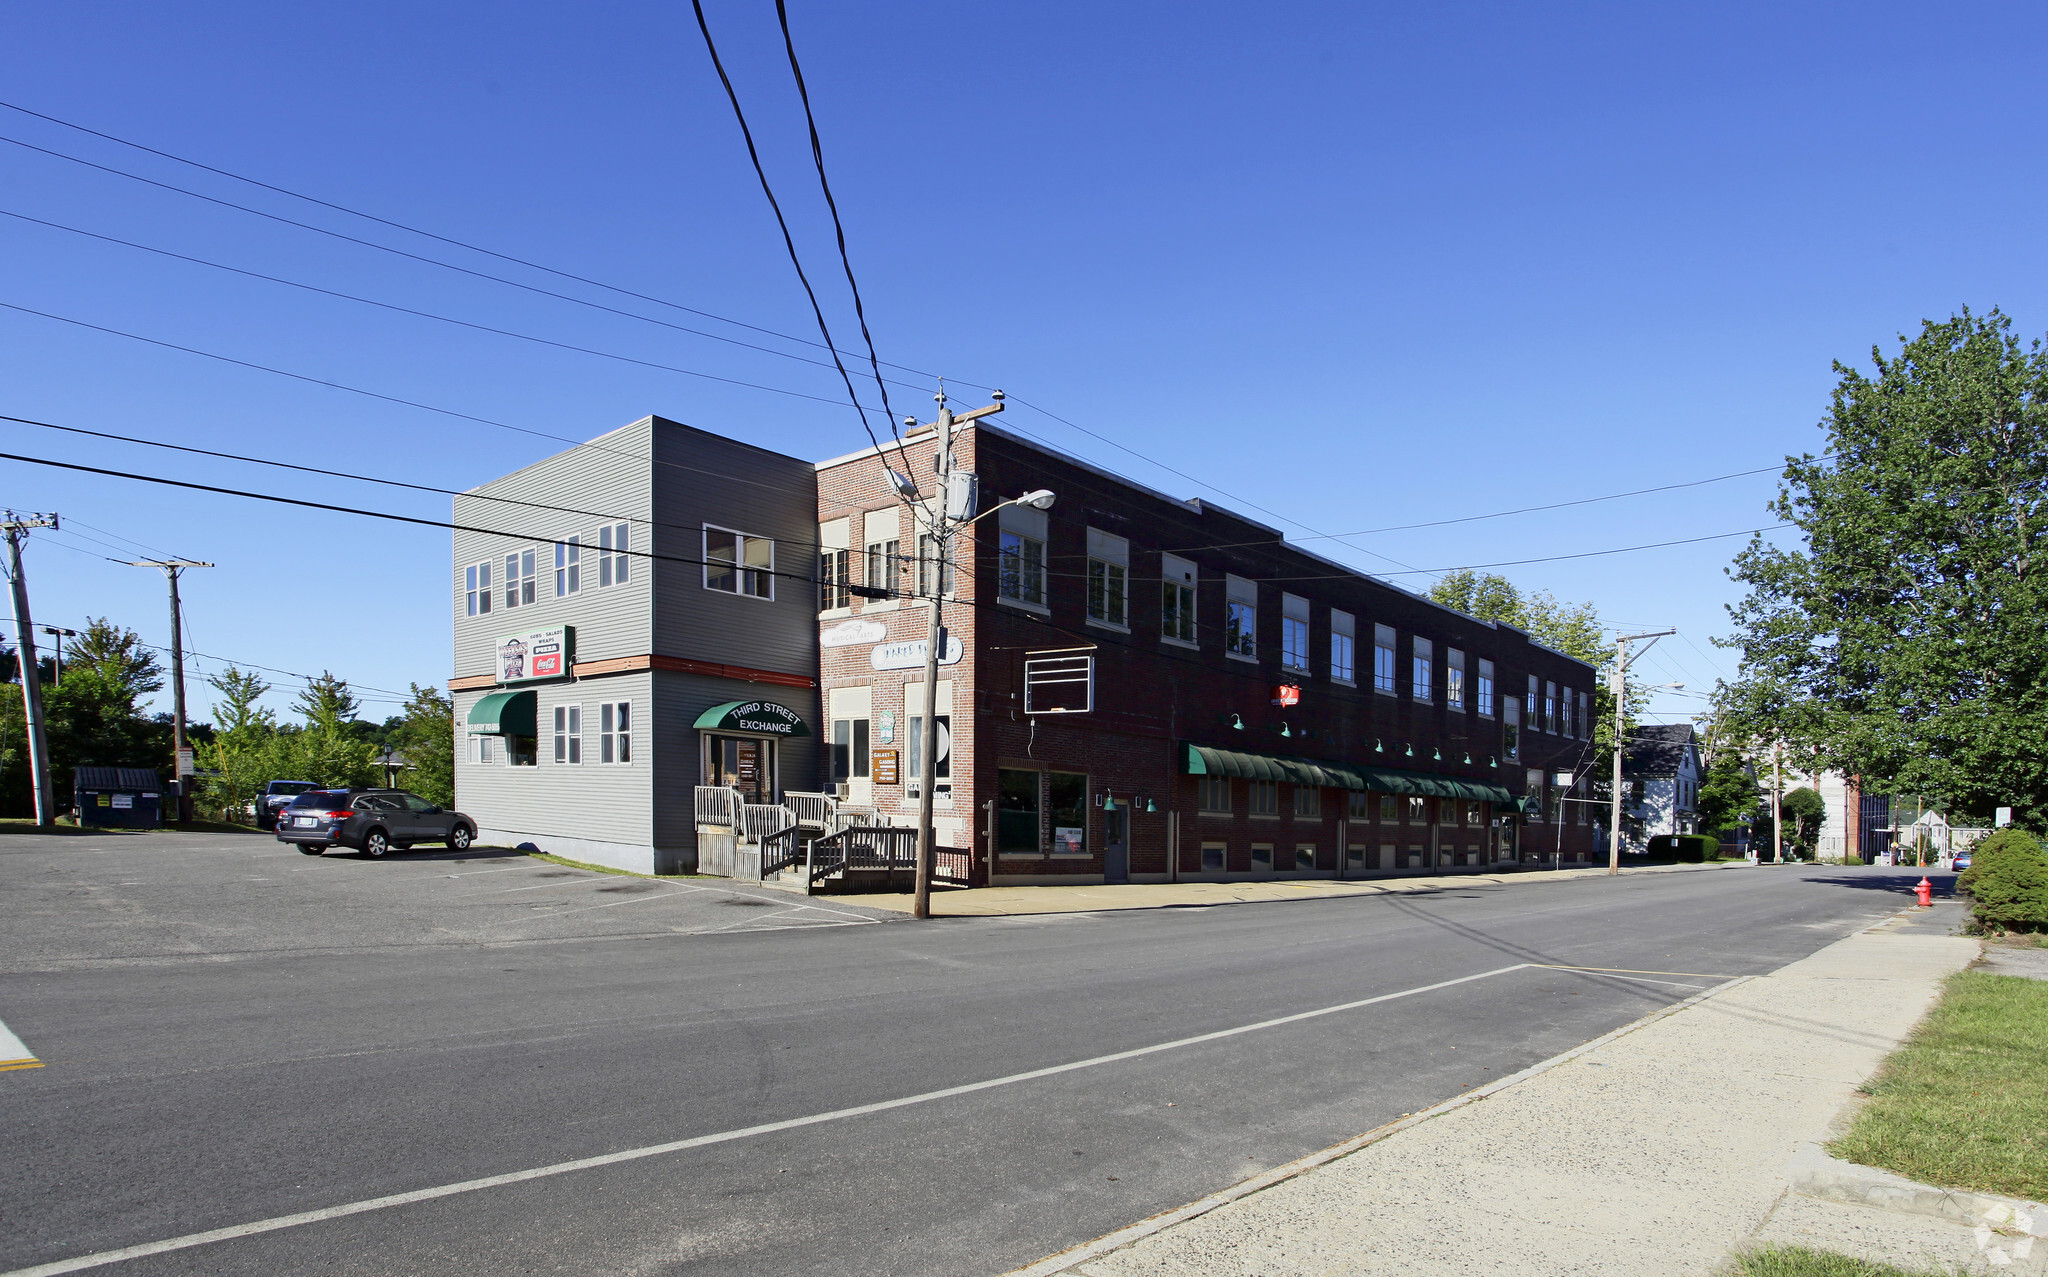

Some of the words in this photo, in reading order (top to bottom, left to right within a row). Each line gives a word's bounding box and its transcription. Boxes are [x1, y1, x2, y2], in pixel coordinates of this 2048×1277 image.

[831, 633, 855, 641] MUSICAL
[535, 645, 558, 653] PIZZA
[730, 702, 760, 719] THIRD
[764, 702, 801, 725] STREET
[740, 719, 792, 733] EXCHANGE
